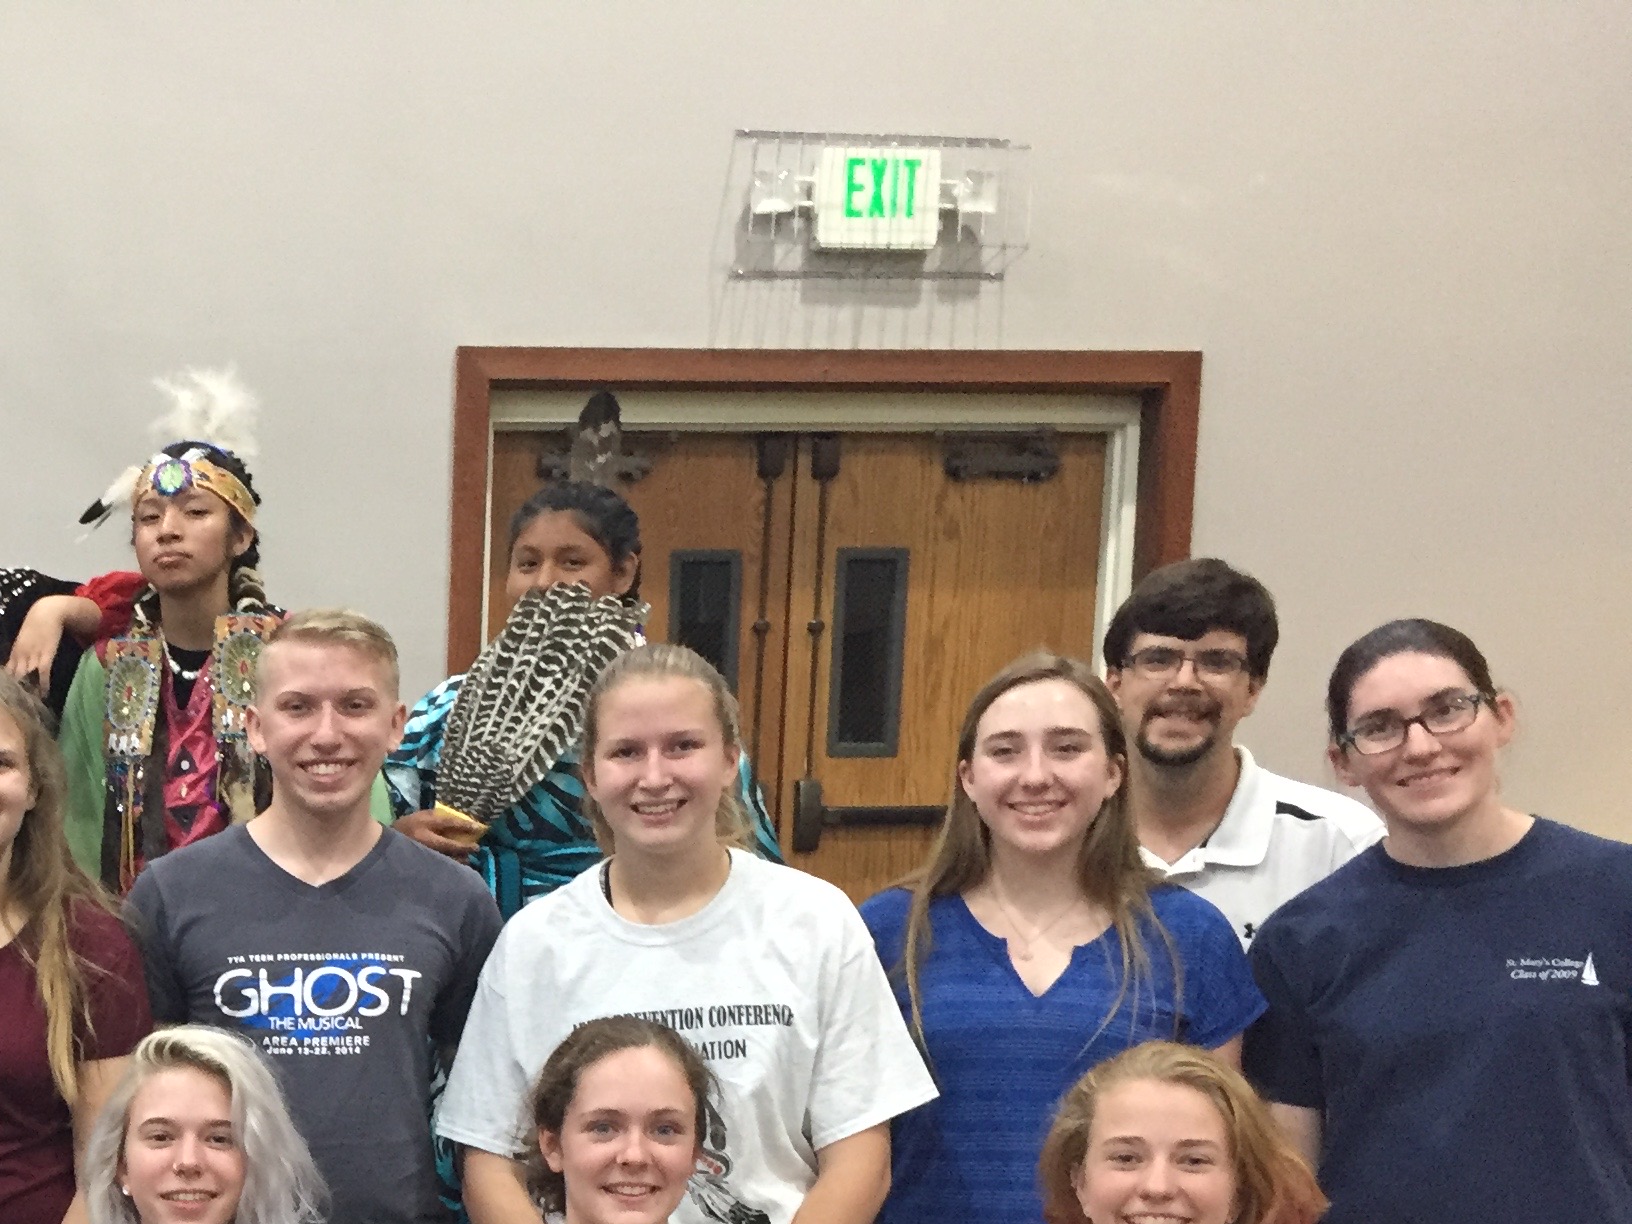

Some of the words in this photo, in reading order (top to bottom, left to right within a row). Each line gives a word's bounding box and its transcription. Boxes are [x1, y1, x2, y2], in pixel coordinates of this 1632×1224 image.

[844, 158, 921, 218] EXIT
[248, 954, 274, 963] TEEN
[276, 952, 358, 961] PROFESSIONALS
[361, 952, 405, 962] PRESENT
[1519, 957, 1550, 968] Mary's
[1510, 969, 1537, 979] Class
[1550, 969, 1578, 979] 2009
[213, 966, 422, 1018] GHOST
[268, 1016, 296, 1030] THE
[297, 1016, 364, 1031] MUSICAL
[262, 1036, 298, 1047] AREA
[303, 1036, 370, 1047] PREMIERE
[266, 1046, 294, 1055] June
[334, 1046, 361, 1055] 2014
[694, 1039, 747, 1060] ATION
